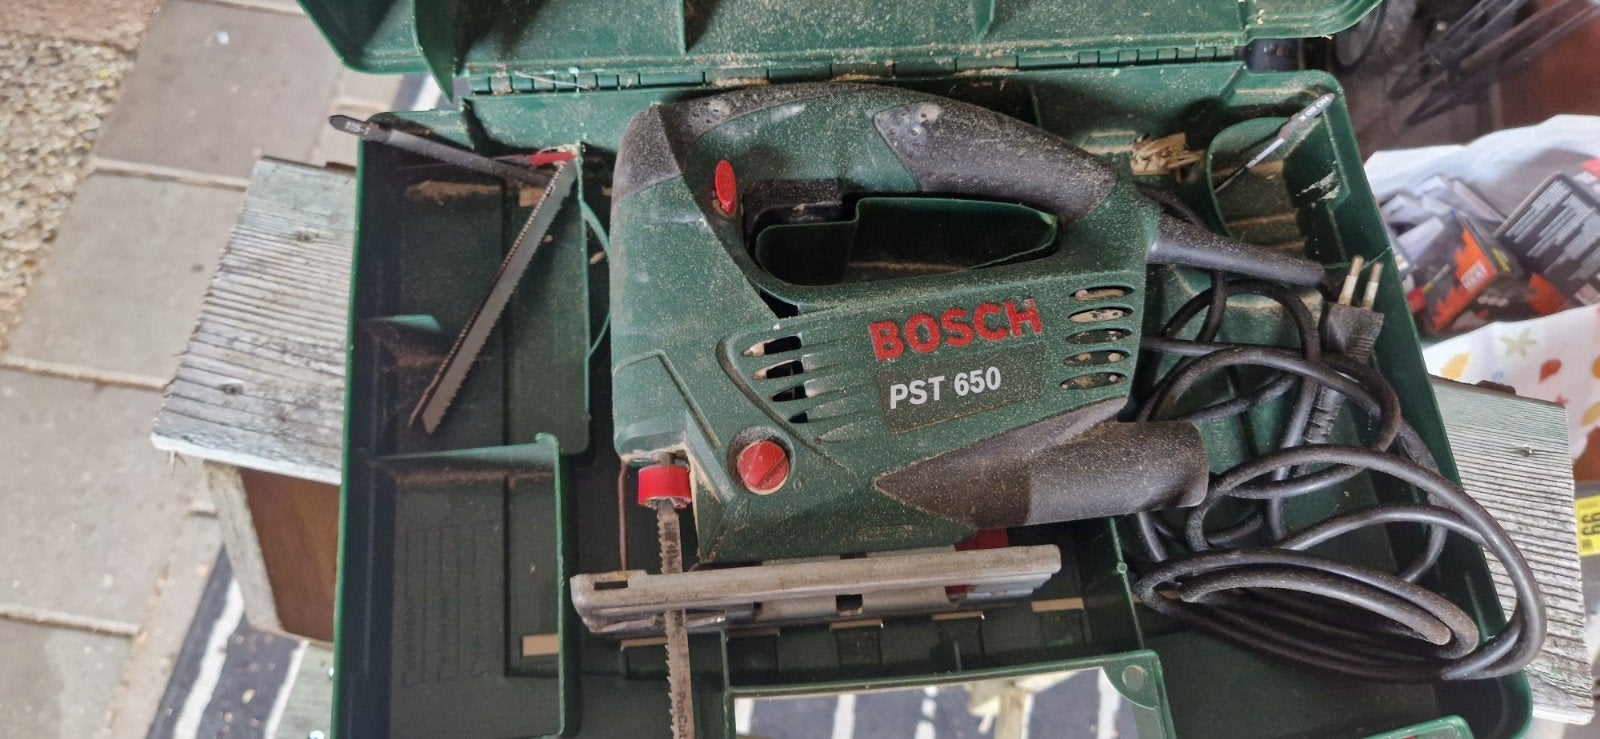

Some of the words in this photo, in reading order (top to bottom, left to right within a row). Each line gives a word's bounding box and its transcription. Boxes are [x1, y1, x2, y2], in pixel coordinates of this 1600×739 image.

[867, 297, 1044, 361] BOSCH
[889, 375, 945, 409] PST
[954, 366, 1001, 397] 650
